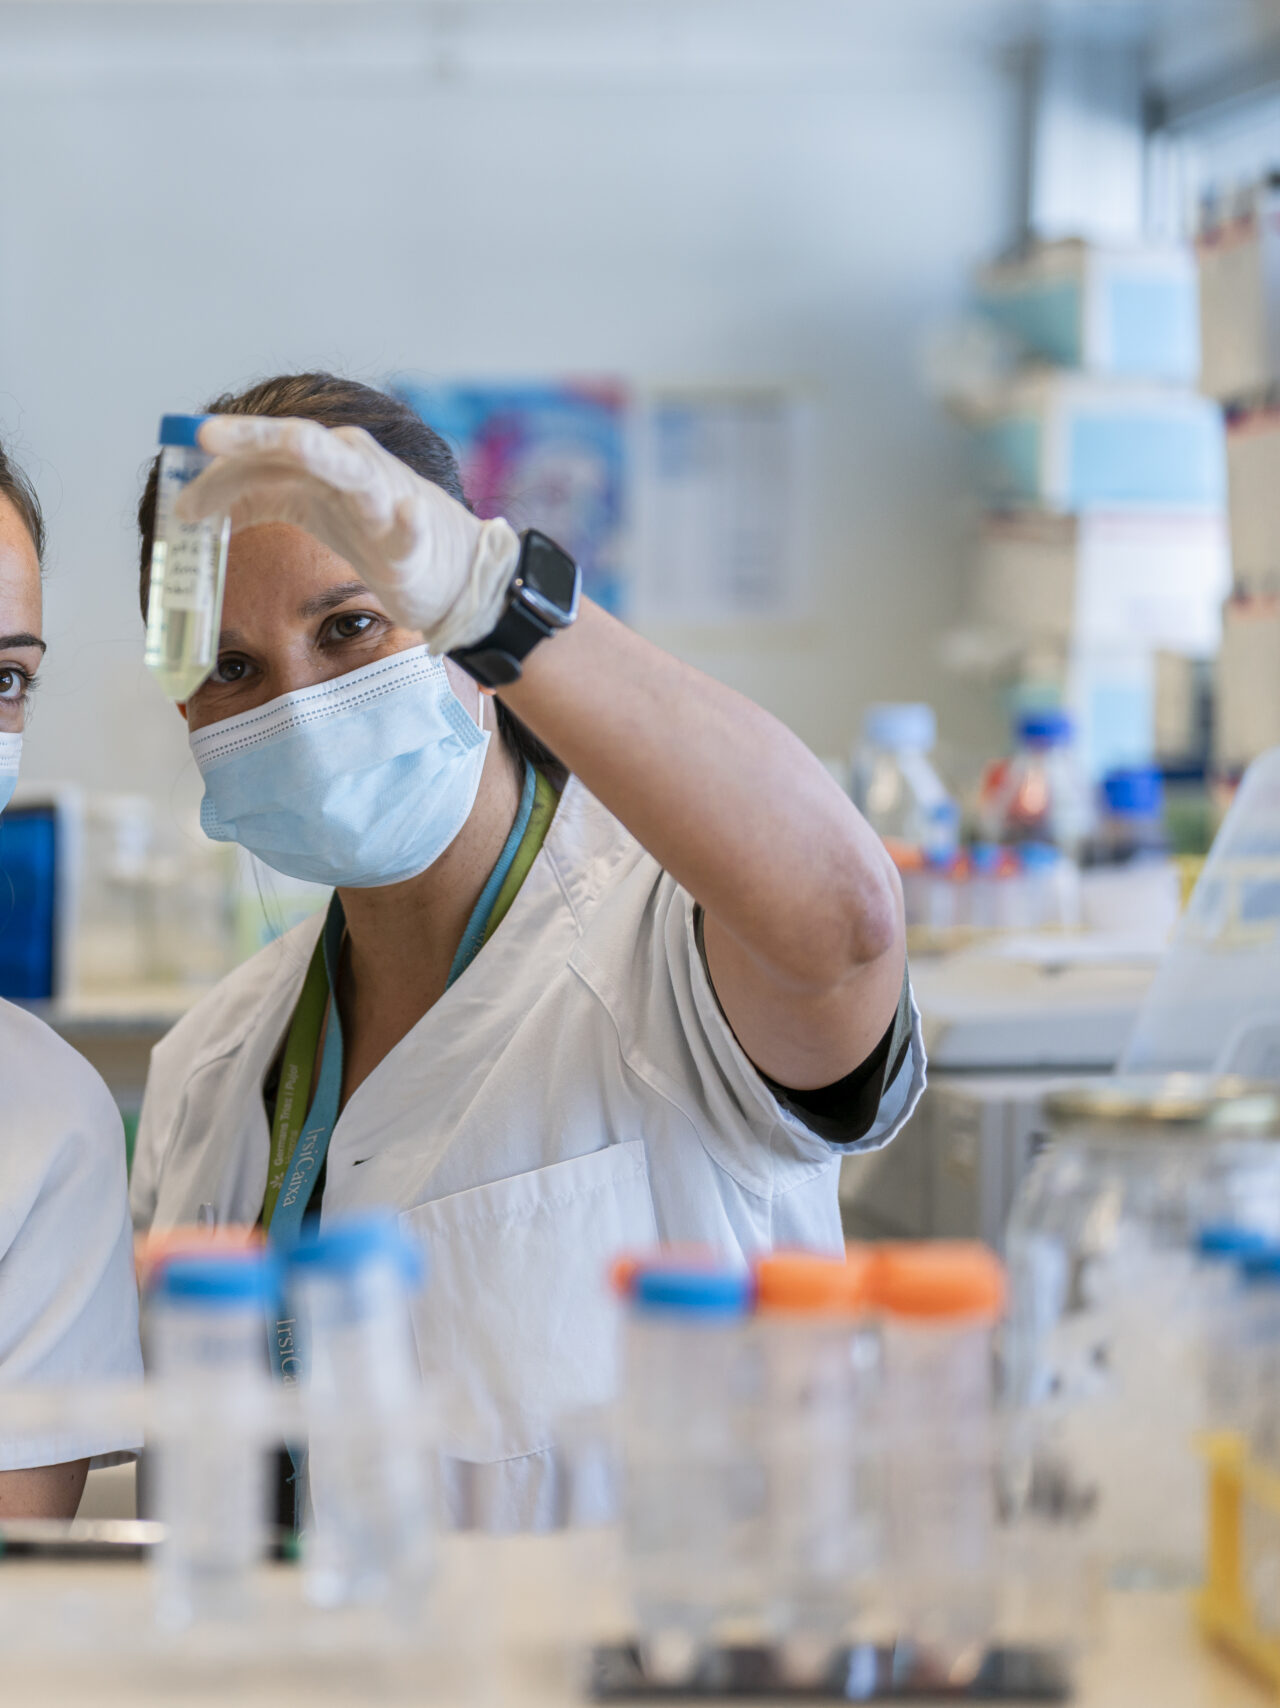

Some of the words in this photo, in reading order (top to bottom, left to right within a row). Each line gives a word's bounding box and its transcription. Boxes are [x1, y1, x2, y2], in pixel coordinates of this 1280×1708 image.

[285, 1064, 299, 1091] Pujol
[280, 1097, 294, 1121] Trias
[274, 1122, 289, 1166] Germans
[282, 1127, 326, 1208] IrsiCaixa
[276, 1318, 304, 1392] IrsiCa
